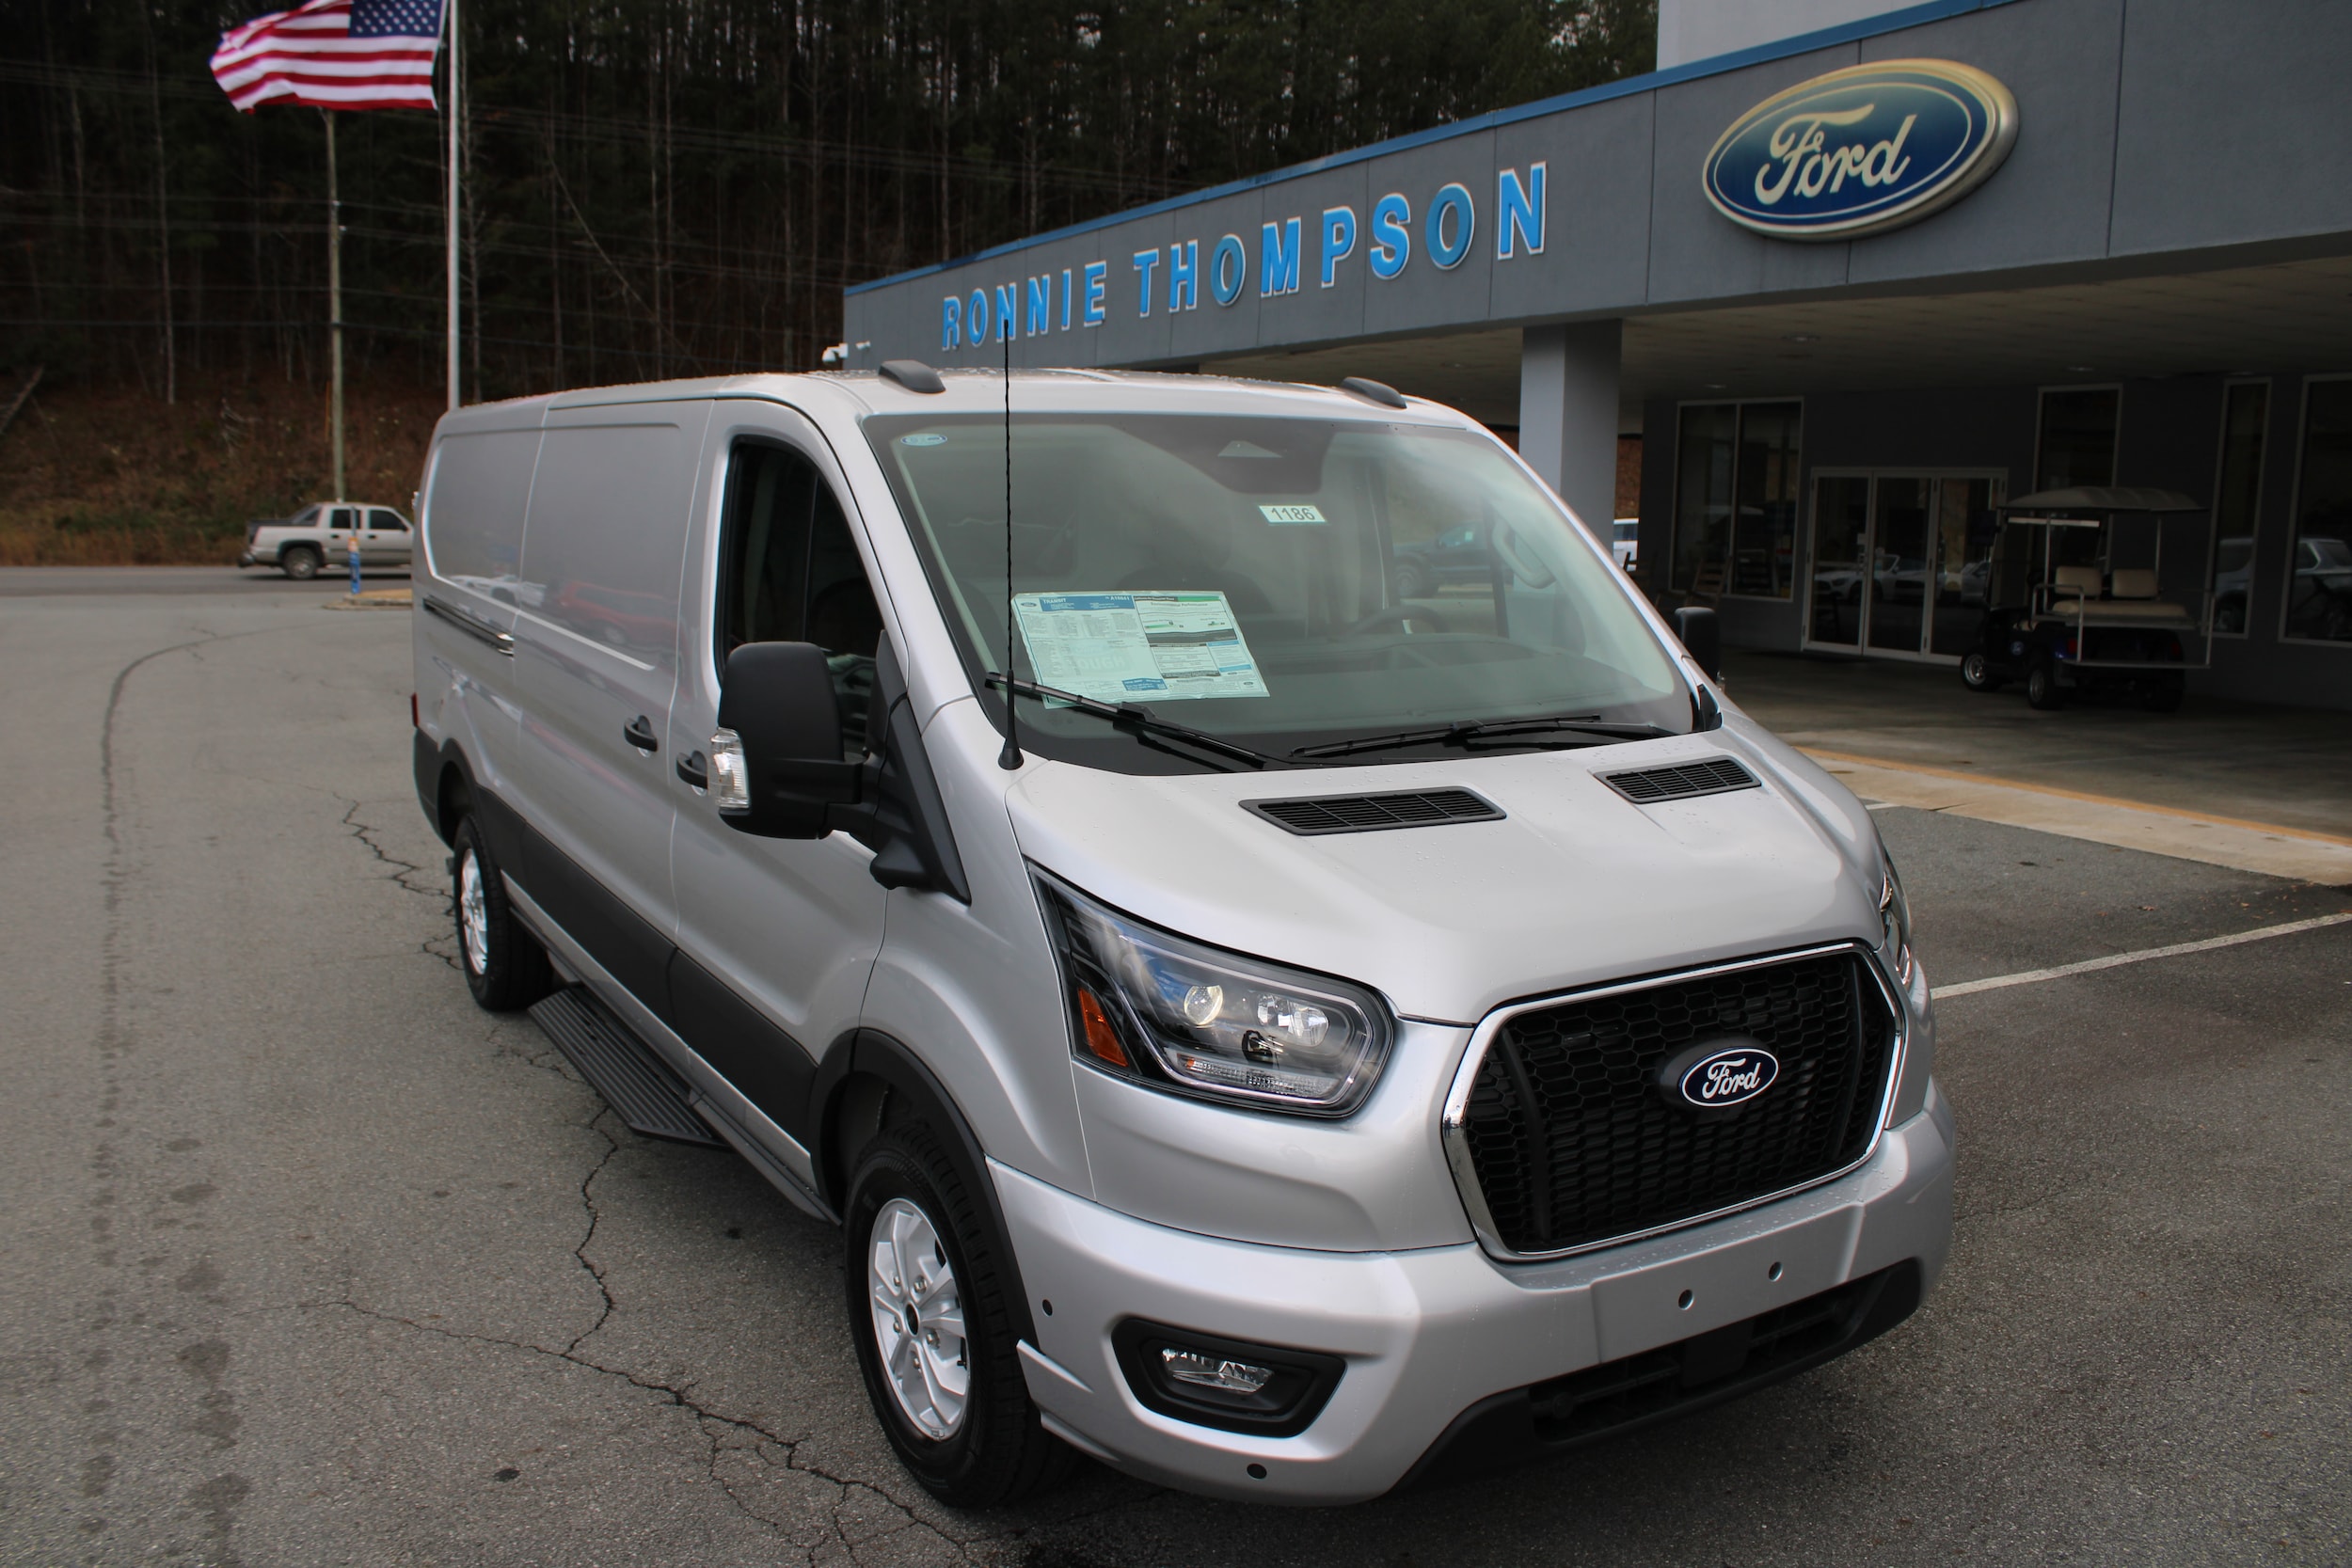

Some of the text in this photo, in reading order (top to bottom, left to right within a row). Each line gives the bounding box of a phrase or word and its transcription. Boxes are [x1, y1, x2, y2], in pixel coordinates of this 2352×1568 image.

[1755, 103, 1917, 205] Ford
[942, 161, 1548, 352] RONNIE THOMPSON
[1271, 508, 1315, 520] 1186
[1701, 1058, 1761, 1100] Ford
